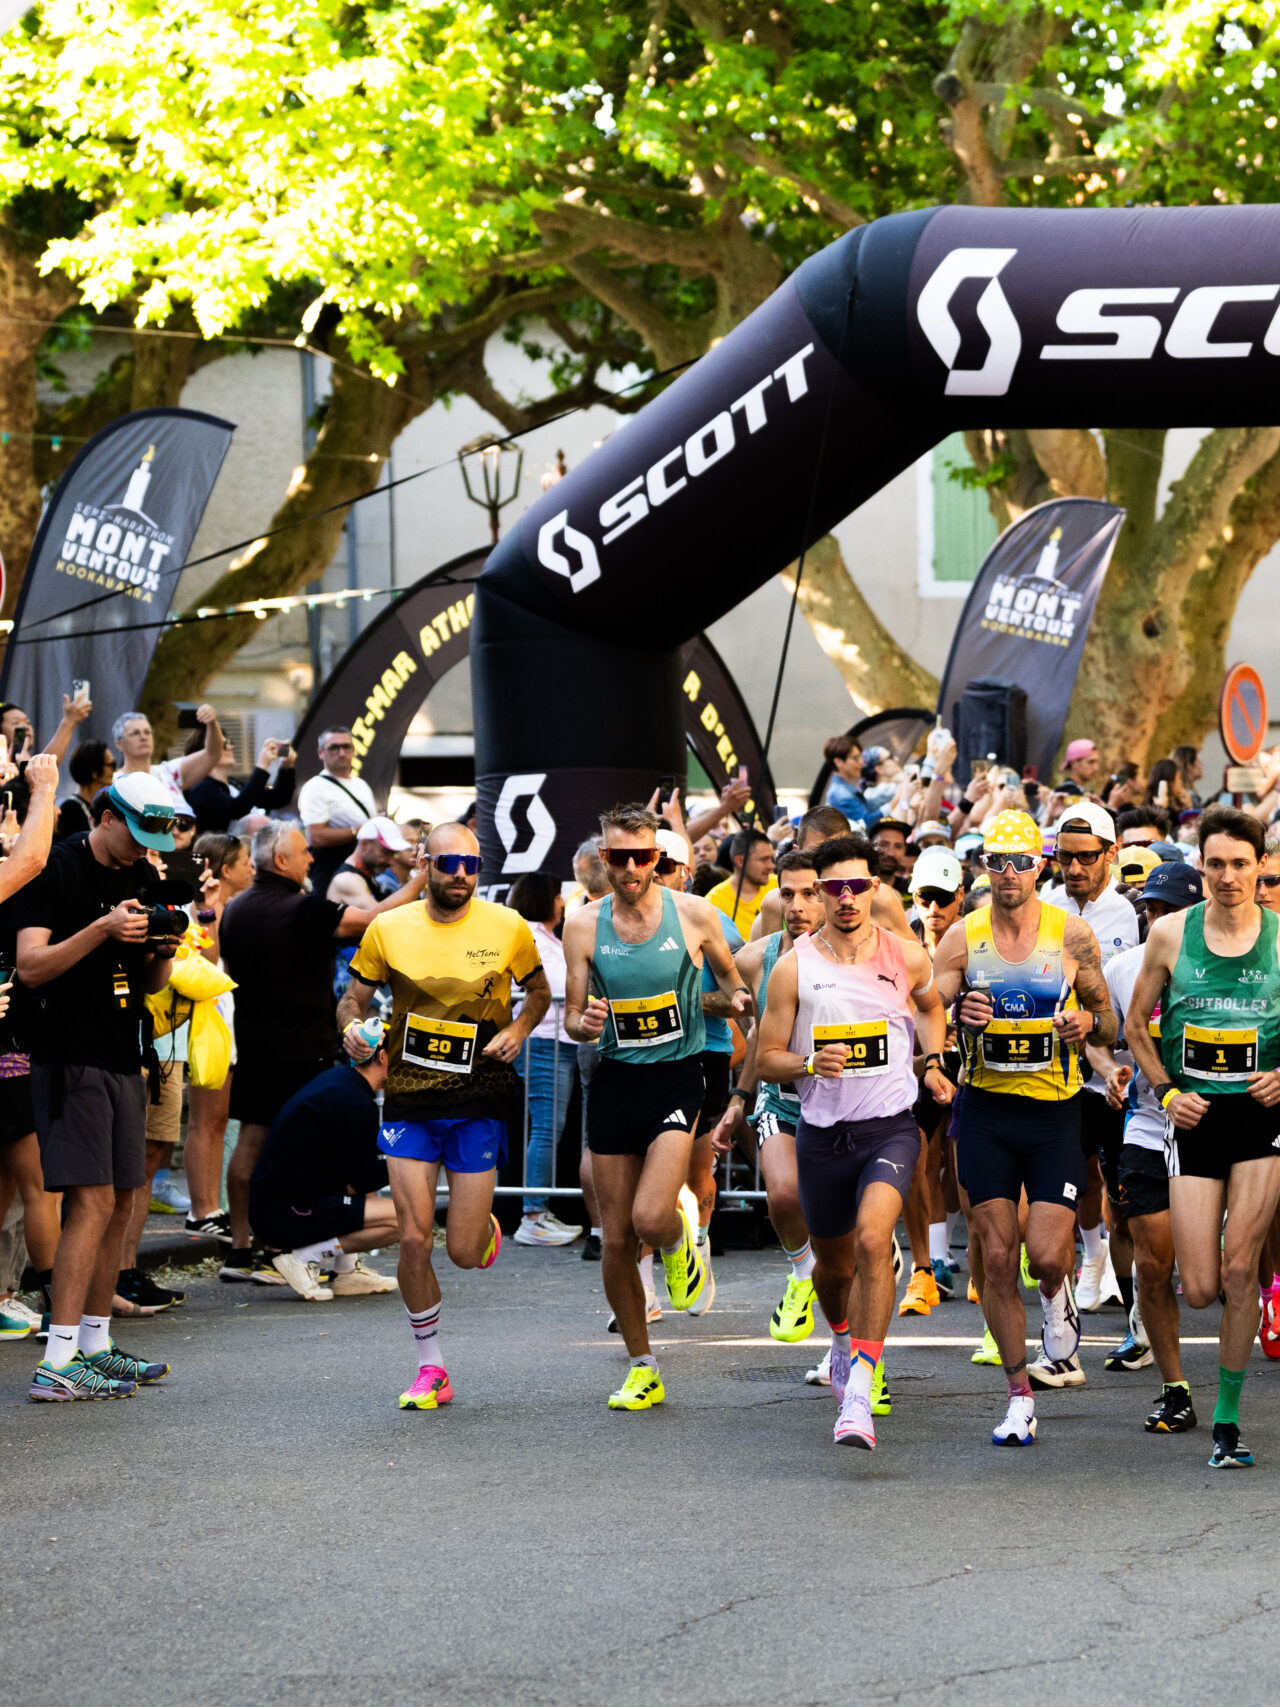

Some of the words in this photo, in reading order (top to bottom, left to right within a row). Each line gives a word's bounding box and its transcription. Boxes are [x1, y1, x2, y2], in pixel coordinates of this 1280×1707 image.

[599, 342, 815, 546] SCOTT
[66, 512, 171, 572] MONT
[74, 502, 176, 546] SEMI-MARATHON
[56, 560, 153, 604] KOOKABARRA
[61, 540, 161, 592] VENTOUX
[988, 581, 1082, 623] MONT
[984, 605, 1076, 638] VENTOUX
[637, 1016, 659, 1031] 16
[1004, 1003, 1026, 1012] CMA
[427, 1038, 452, 1054] 20
[1008, 1039, 1030, 1054] 12
[1215, 1049, 1227, 1064] 1
